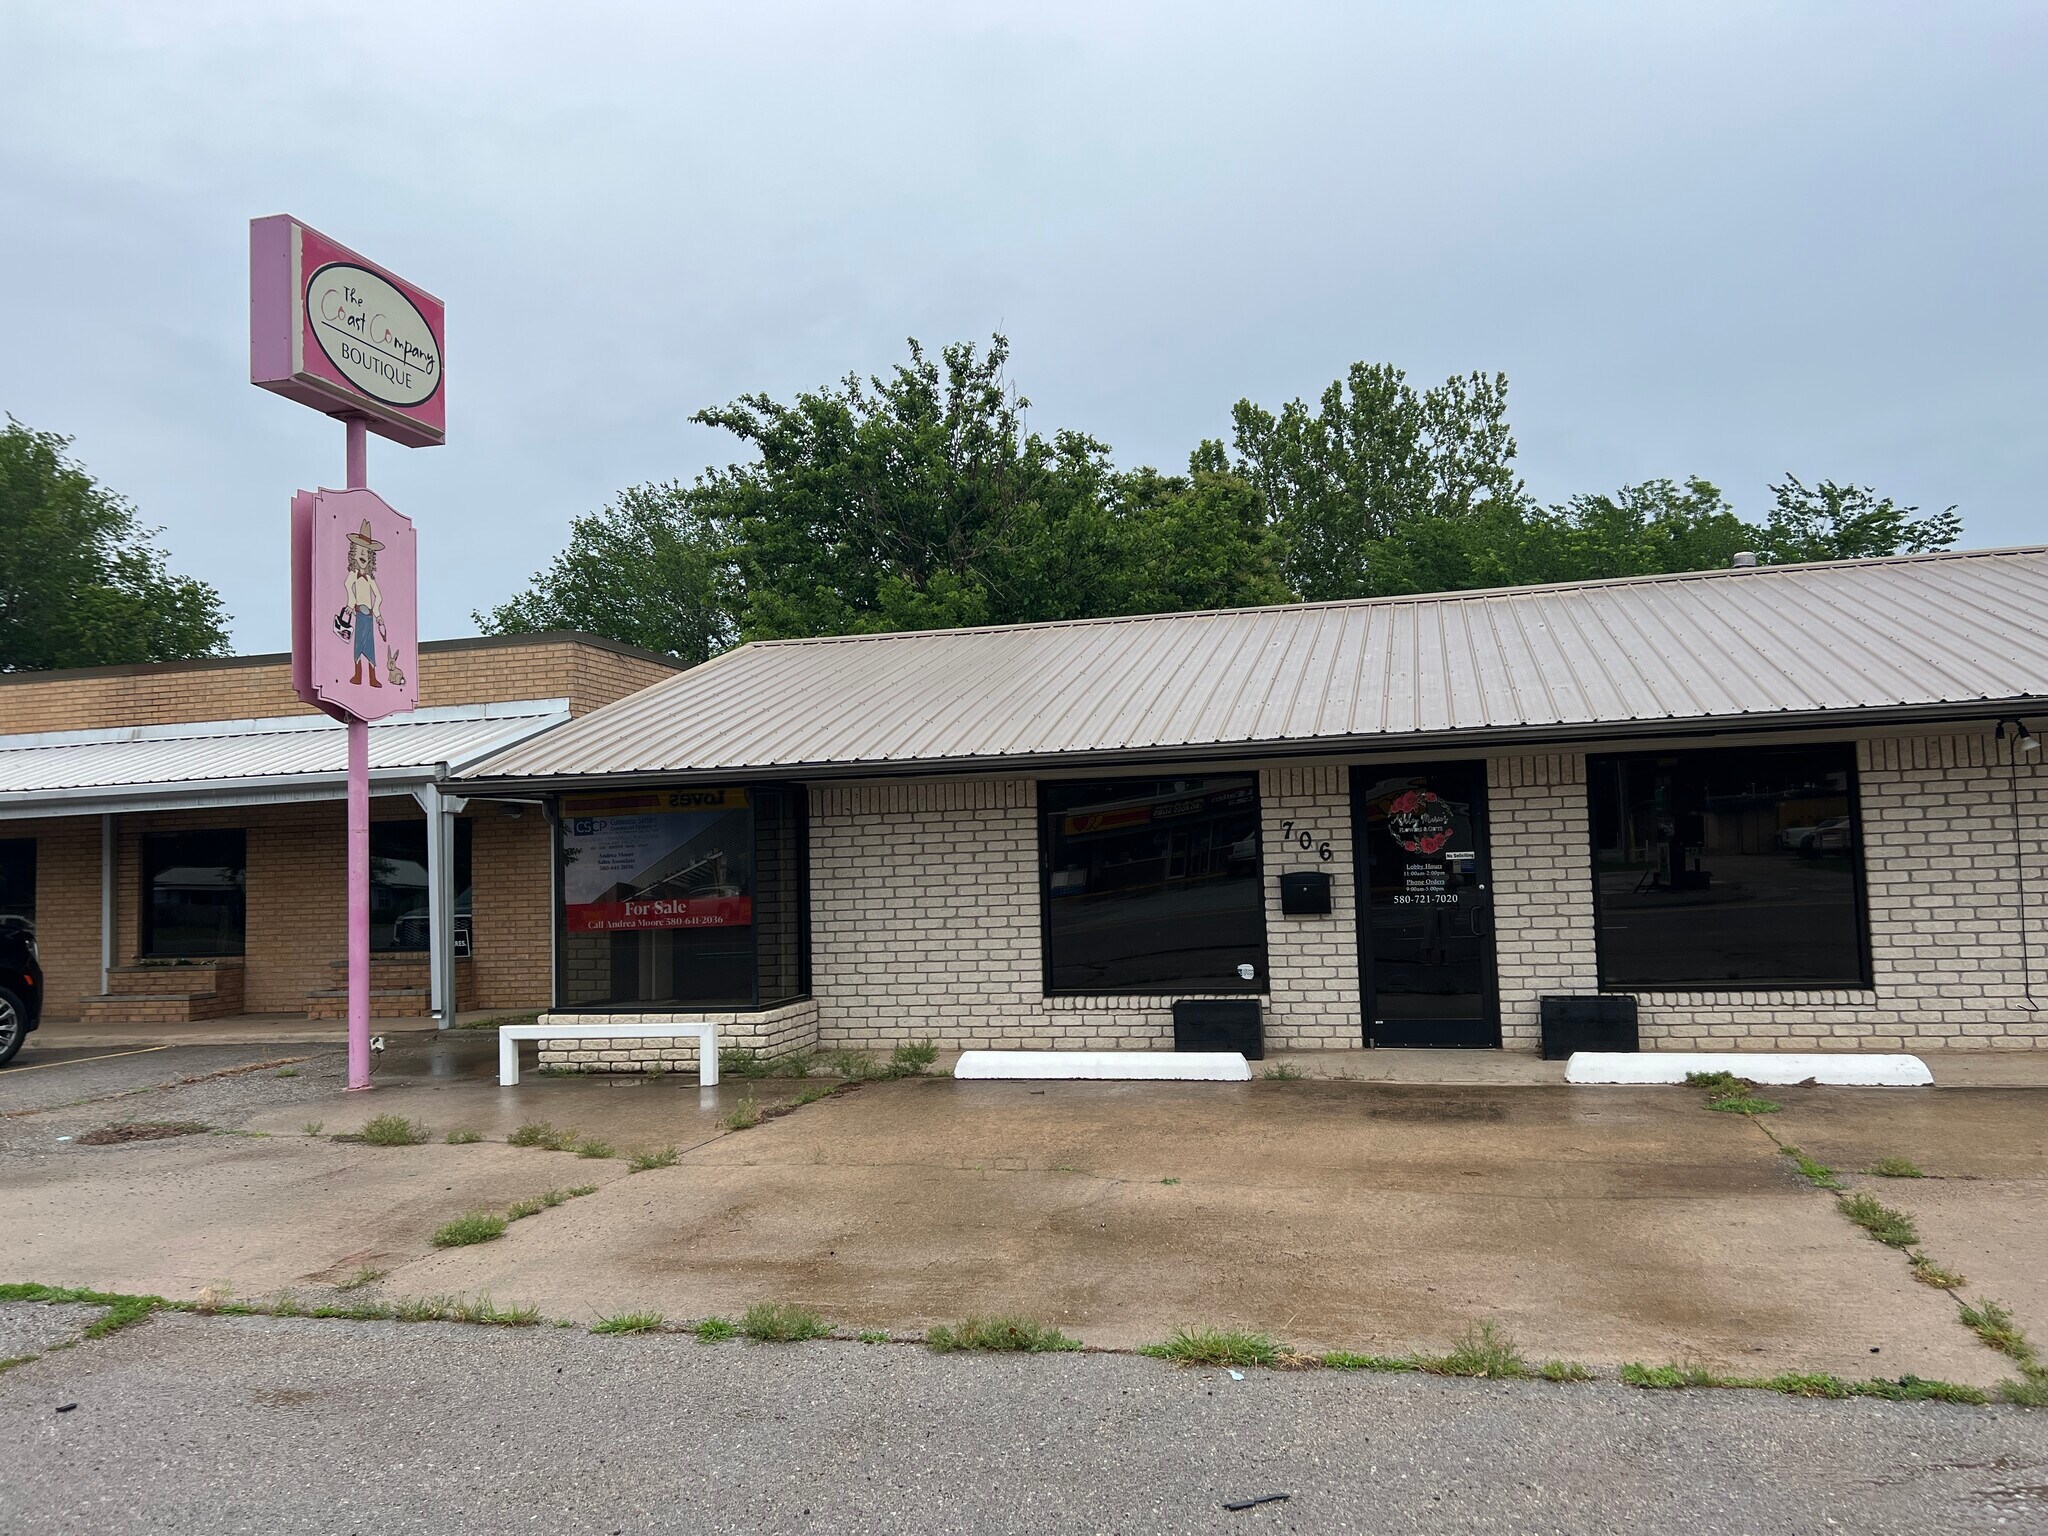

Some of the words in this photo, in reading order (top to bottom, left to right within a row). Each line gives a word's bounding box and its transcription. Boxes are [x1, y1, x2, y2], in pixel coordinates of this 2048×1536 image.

[343, 285, 363, 307] The
[369, 313, 436, 375] Company
[341, 342, 412, 389] BOUTIQUE
[576, 820, 607, 833] CSCP
[1283, 821, 1331, 861] 706
[624, 901, 651, 916] For
[654, 900, 687, 915] Sale
[1393, 894, 1458, 904] 580-721-7020
[588, 921, 604, 930] Call
[607, 919, 636, 929] Andrea
[637, 918, 664, 928] Moore
[665, 916, 724, 926] 580-641-2036
